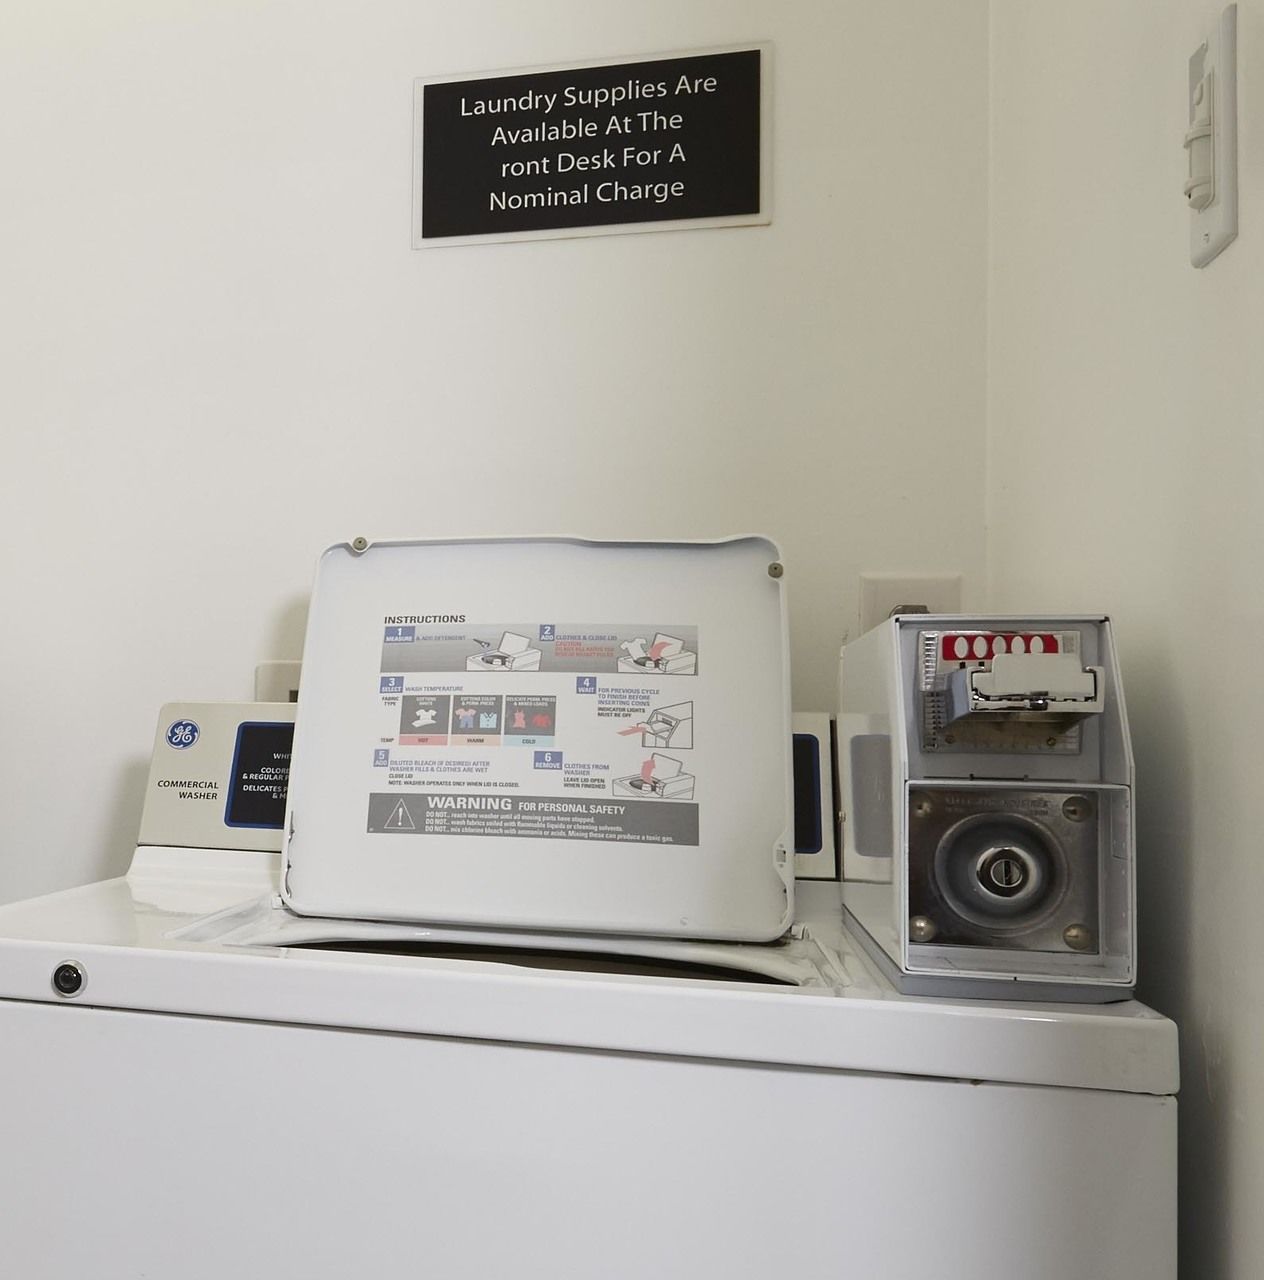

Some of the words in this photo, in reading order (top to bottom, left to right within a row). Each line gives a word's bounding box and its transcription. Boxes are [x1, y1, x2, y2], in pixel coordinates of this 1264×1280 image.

[460, 88, 557, 117] Laundry
[563, 80, 667, 109] Supplies
[674, 74, 718, 96] Are
[490, 117, 597, 146] Available
[604, 115, 631, 136] At
[637, 110, 683, 132] The
[557, 148, 616, 173] Desk
[623, 145, 661, 168] For
[668, 143, 687, 162] A
[489, 183, 588, 212] Nominal
[595, 180, 685, 204] Charge
[384, 615, 466, 624] INSTRUCTIONS
[544, 626, 551, 634] 2
[388, 678, 395, 686] 3
[379, 751, 385, 759] 5
[544, 753, 551, 761] 6
[157, 780, 218, 789] COMMERCIAL
[243, 784, 282, 792] DELICATES
[179, 791, 217, 800] WASHER
[427, 796, 512, 810] WARNING
[519, 802, 536, 811] FOR
[538, 803, 587, 813] PERSONAL
[590, 805, 625, 815] SAFETY
